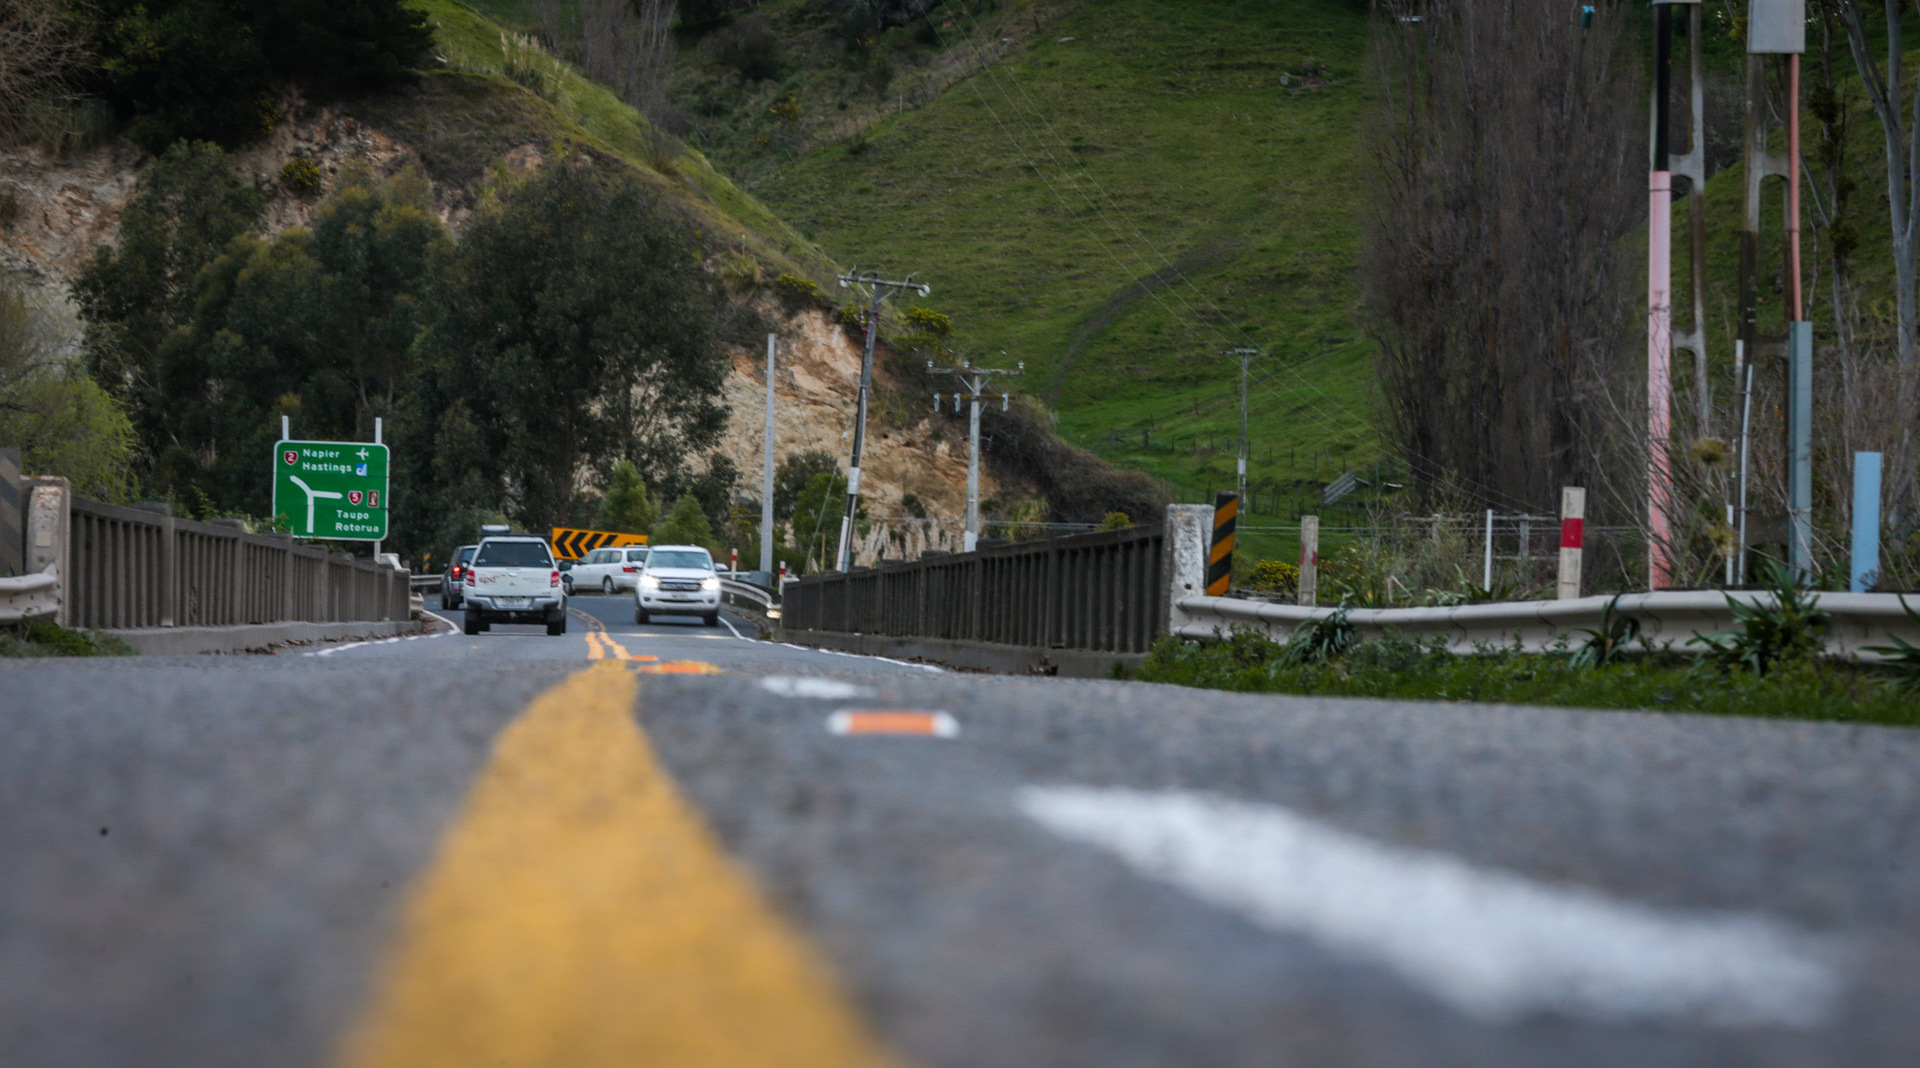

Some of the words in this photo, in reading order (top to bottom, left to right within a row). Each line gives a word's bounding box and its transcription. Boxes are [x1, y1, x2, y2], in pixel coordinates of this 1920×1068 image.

[303, 449, 340, 459] Napier
[302, 462, 352, 474] Hastings
[336, 510, 370, 521] Taupo
[335, 522, 379, 533] Rotorua
